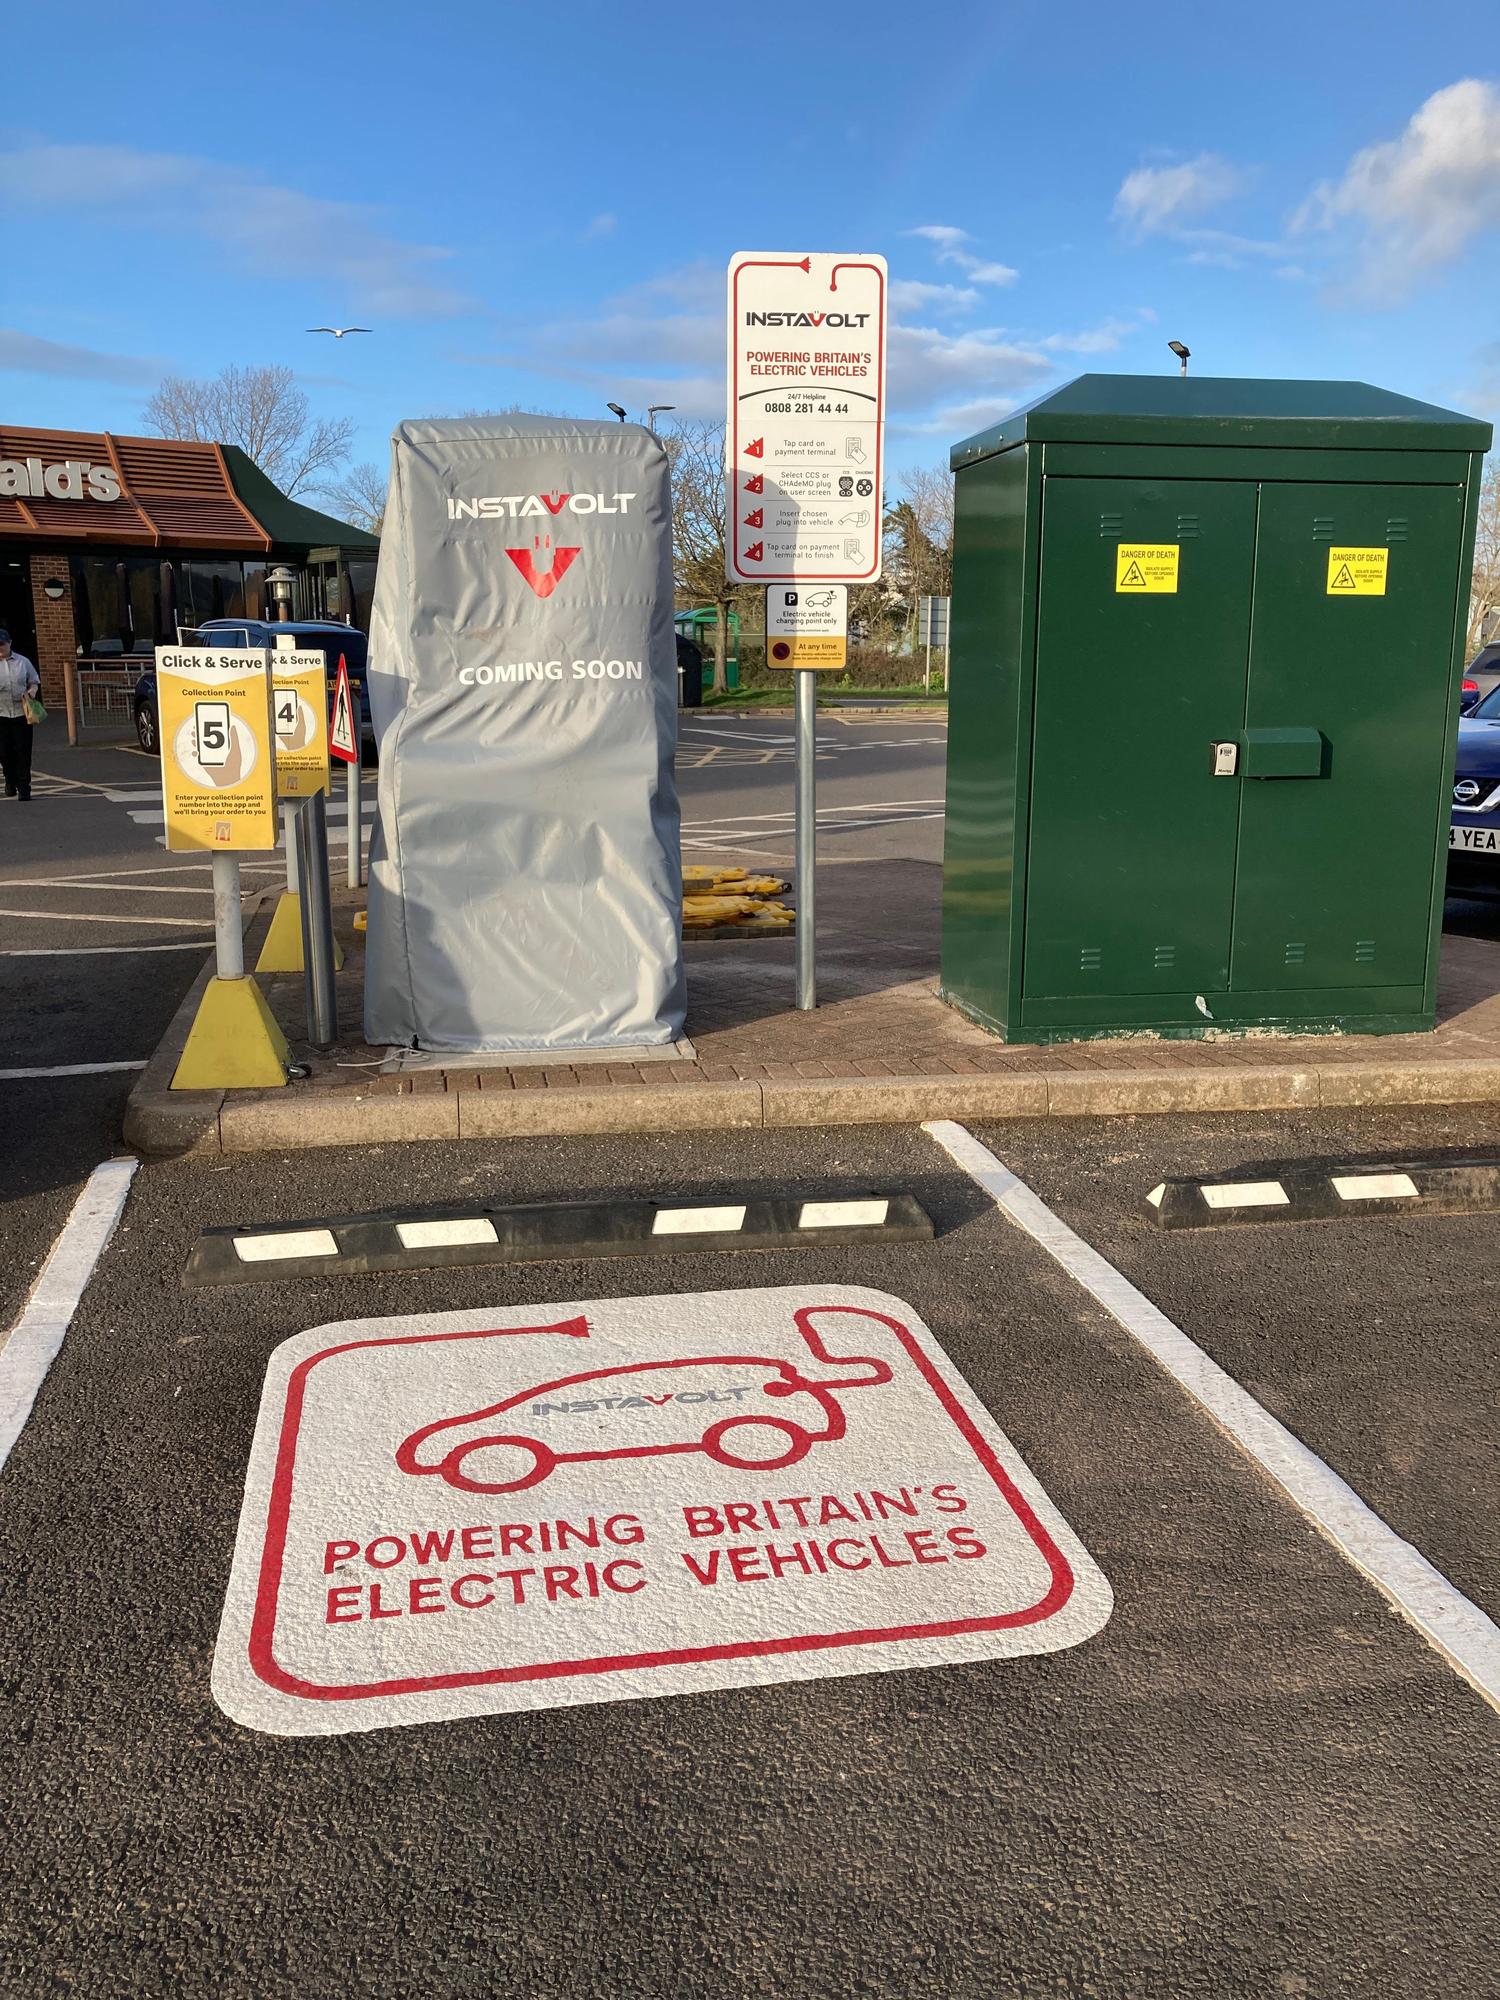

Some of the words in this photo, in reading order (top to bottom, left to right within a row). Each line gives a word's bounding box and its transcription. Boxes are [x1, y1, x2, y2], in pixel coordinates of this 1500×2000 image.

[746, 311, 870, 328] INSTAVOLT
[746, 351, 810, 362] POWERING
[814, 352, 871, 364] BRITAIN'S
[750, 364, 806, 376] ELECTRIC
[810, 365, 867, 376] VEHICLES
[765, 402, 791, 413] 0808
[795, 403, 813, 413] 281
[818, 403, 831, 413] 44
[835, 403, 848, 414] 44
[755, 446, 760, 454] 1
[784, 440, 796, 448] Tap
[448, 490, 637, 519] INSTAVOLT
[755, 517, 760, 525] 3
[776, 519, 791, 527] plug
[1121, 550, 1146, 558] DANGER
[788, 594, 796, 604] P
[162, 655, 202, 668] Click
[204, 656, 216, 668] &
[220, 656, 263, 669] Serve
[280, 656, 288, 664] &
[290, 656, 321, 665] Serve
[458, 660, 563, 685] COMING
[572, 660, 642, 680] SOON
[182, 688, 223, 697] Collection
[224, 689, 246, 697] Point
[277, 702, 294, 722] 4
[202, 721, 225, 750] 5
[1462, 830, 1496, 849] YEA
[532, 1387, 752, 1416] INSTAVOLT
[324, 1514, 645, 1574] POWERING
[682, 1484, 968, 1539] BRITAIN'S
[325, 1559, 648, 1624] ELECTRIC
[680, 1526, 987, 1586] VEHICLES
